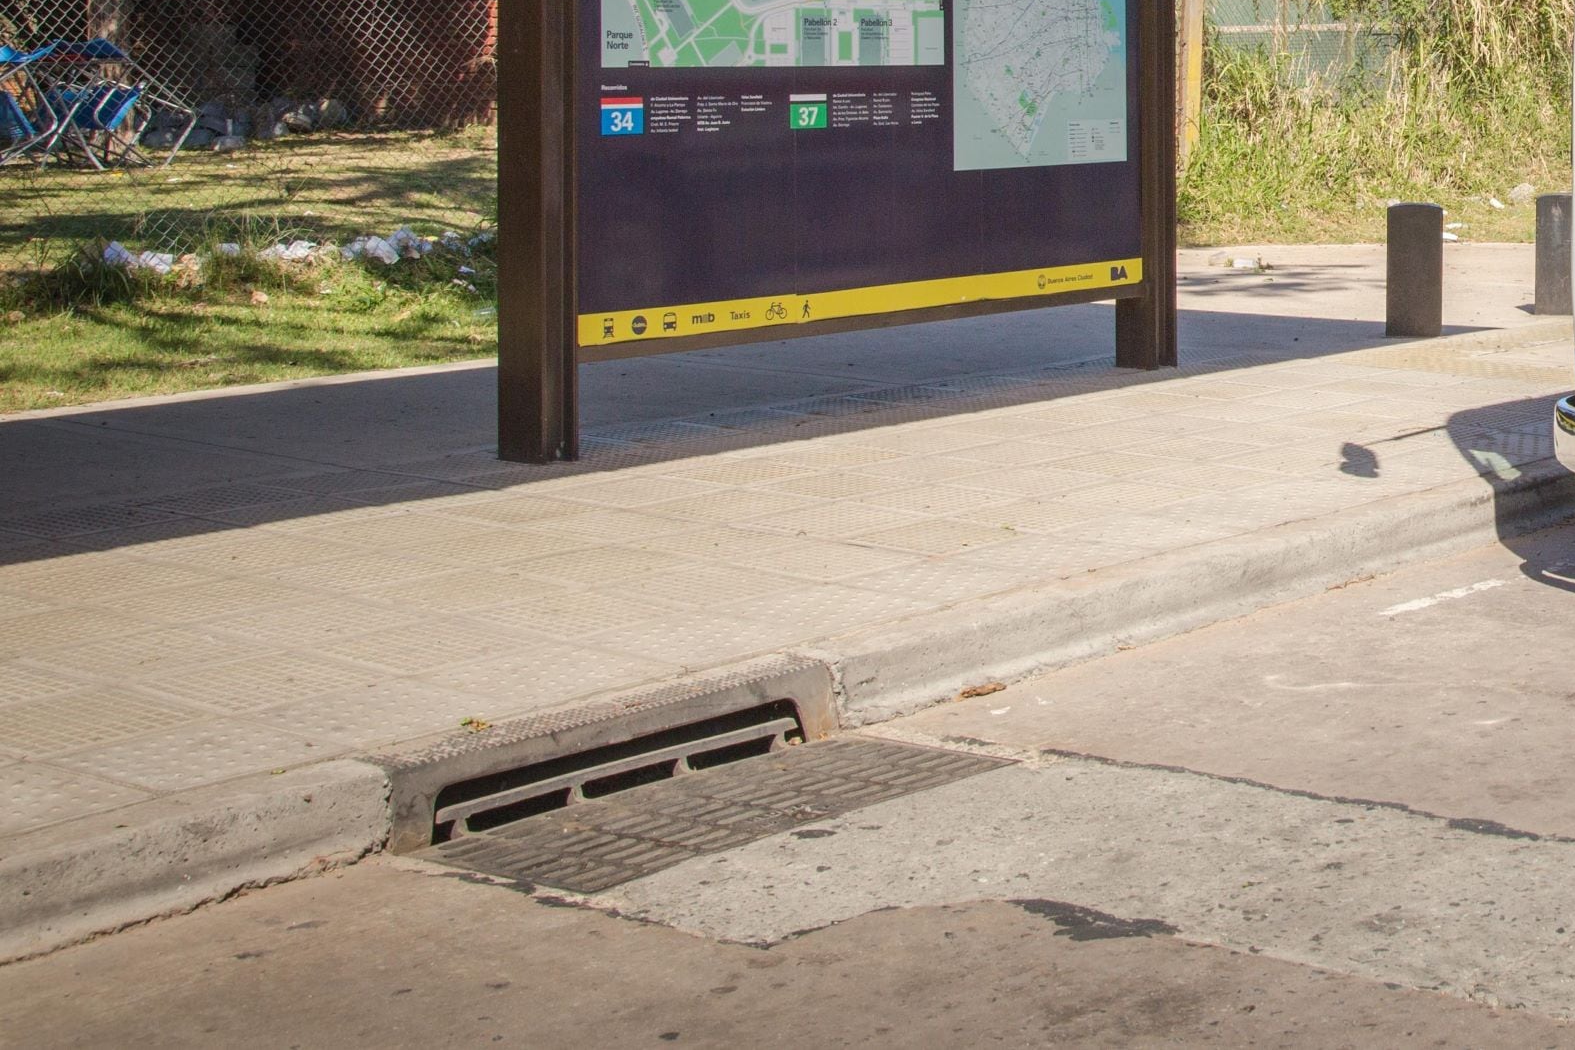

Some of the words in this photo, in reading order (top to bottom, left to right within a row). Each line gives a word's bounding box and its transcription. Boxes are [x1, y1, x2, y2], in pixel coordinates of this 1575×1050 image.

[832, 18, 838, 26] 2
[606, 30, 633, 40] Parque
[606, 41, 629, 50] Norte
[610, 111, 635, 132] 34
[798, 106, 819, 126] 37
[1110, 265, 1128, 282] BA
[729, 310, 751, 321] Taxis
